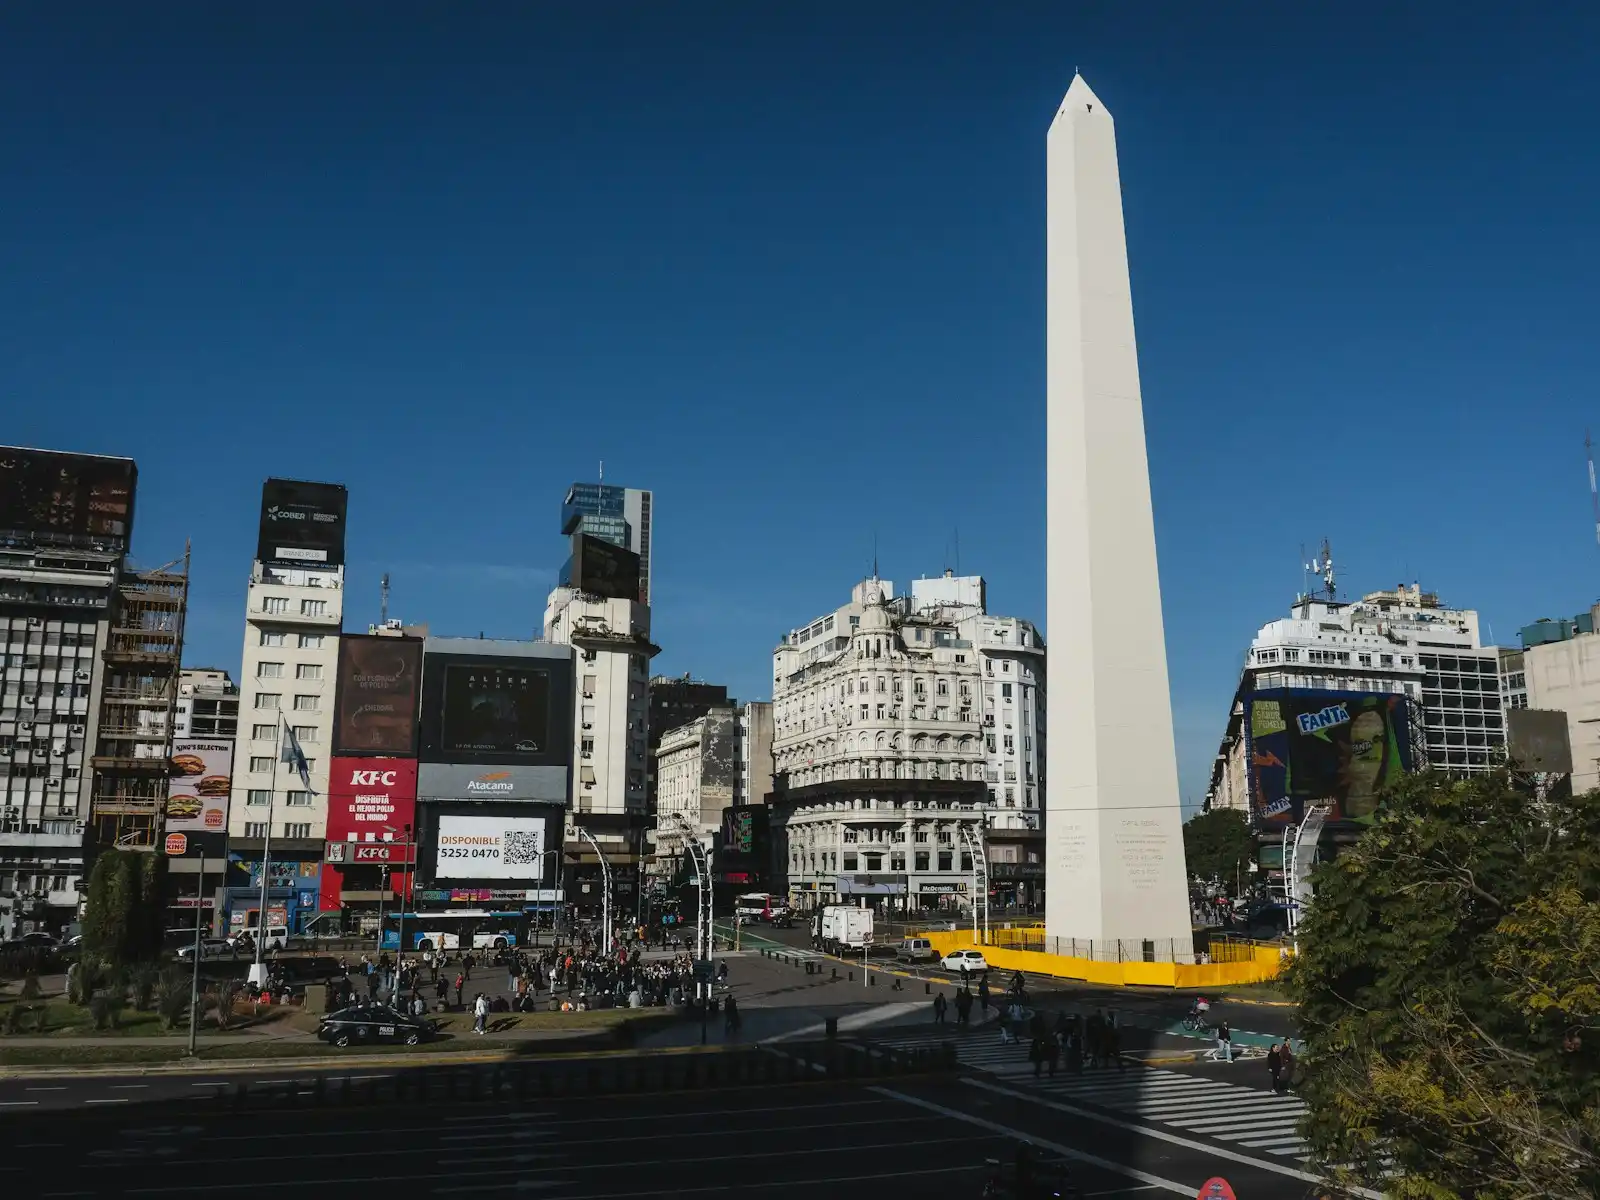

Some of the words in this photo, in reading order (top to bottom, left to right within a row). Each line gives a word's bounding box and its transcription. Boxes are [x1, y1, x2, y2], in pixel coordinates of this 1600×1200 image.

[278, 511, 306, 520] COBER
[469, 675, 527, 685] ALIEN
[1299, 705, 1348, 732] FANTA
[176, 744, 196, 752] KING'S
[350, 770, 397, 786] KFC
[467, 780, 513, 790] Atacama
[348, 804, 356, 812] EL
[376, 805, 395, 813] POLLO
[1261, 799, 1290, 816] FANTA
[355, 813, 366, 821] DEL
[441, 836, 501, 846] DISPONIBLE
[357, 847, 390, 859] KFC
[441, 848, 469, 858] 5252
[472, 849, 500, 858] 0470
